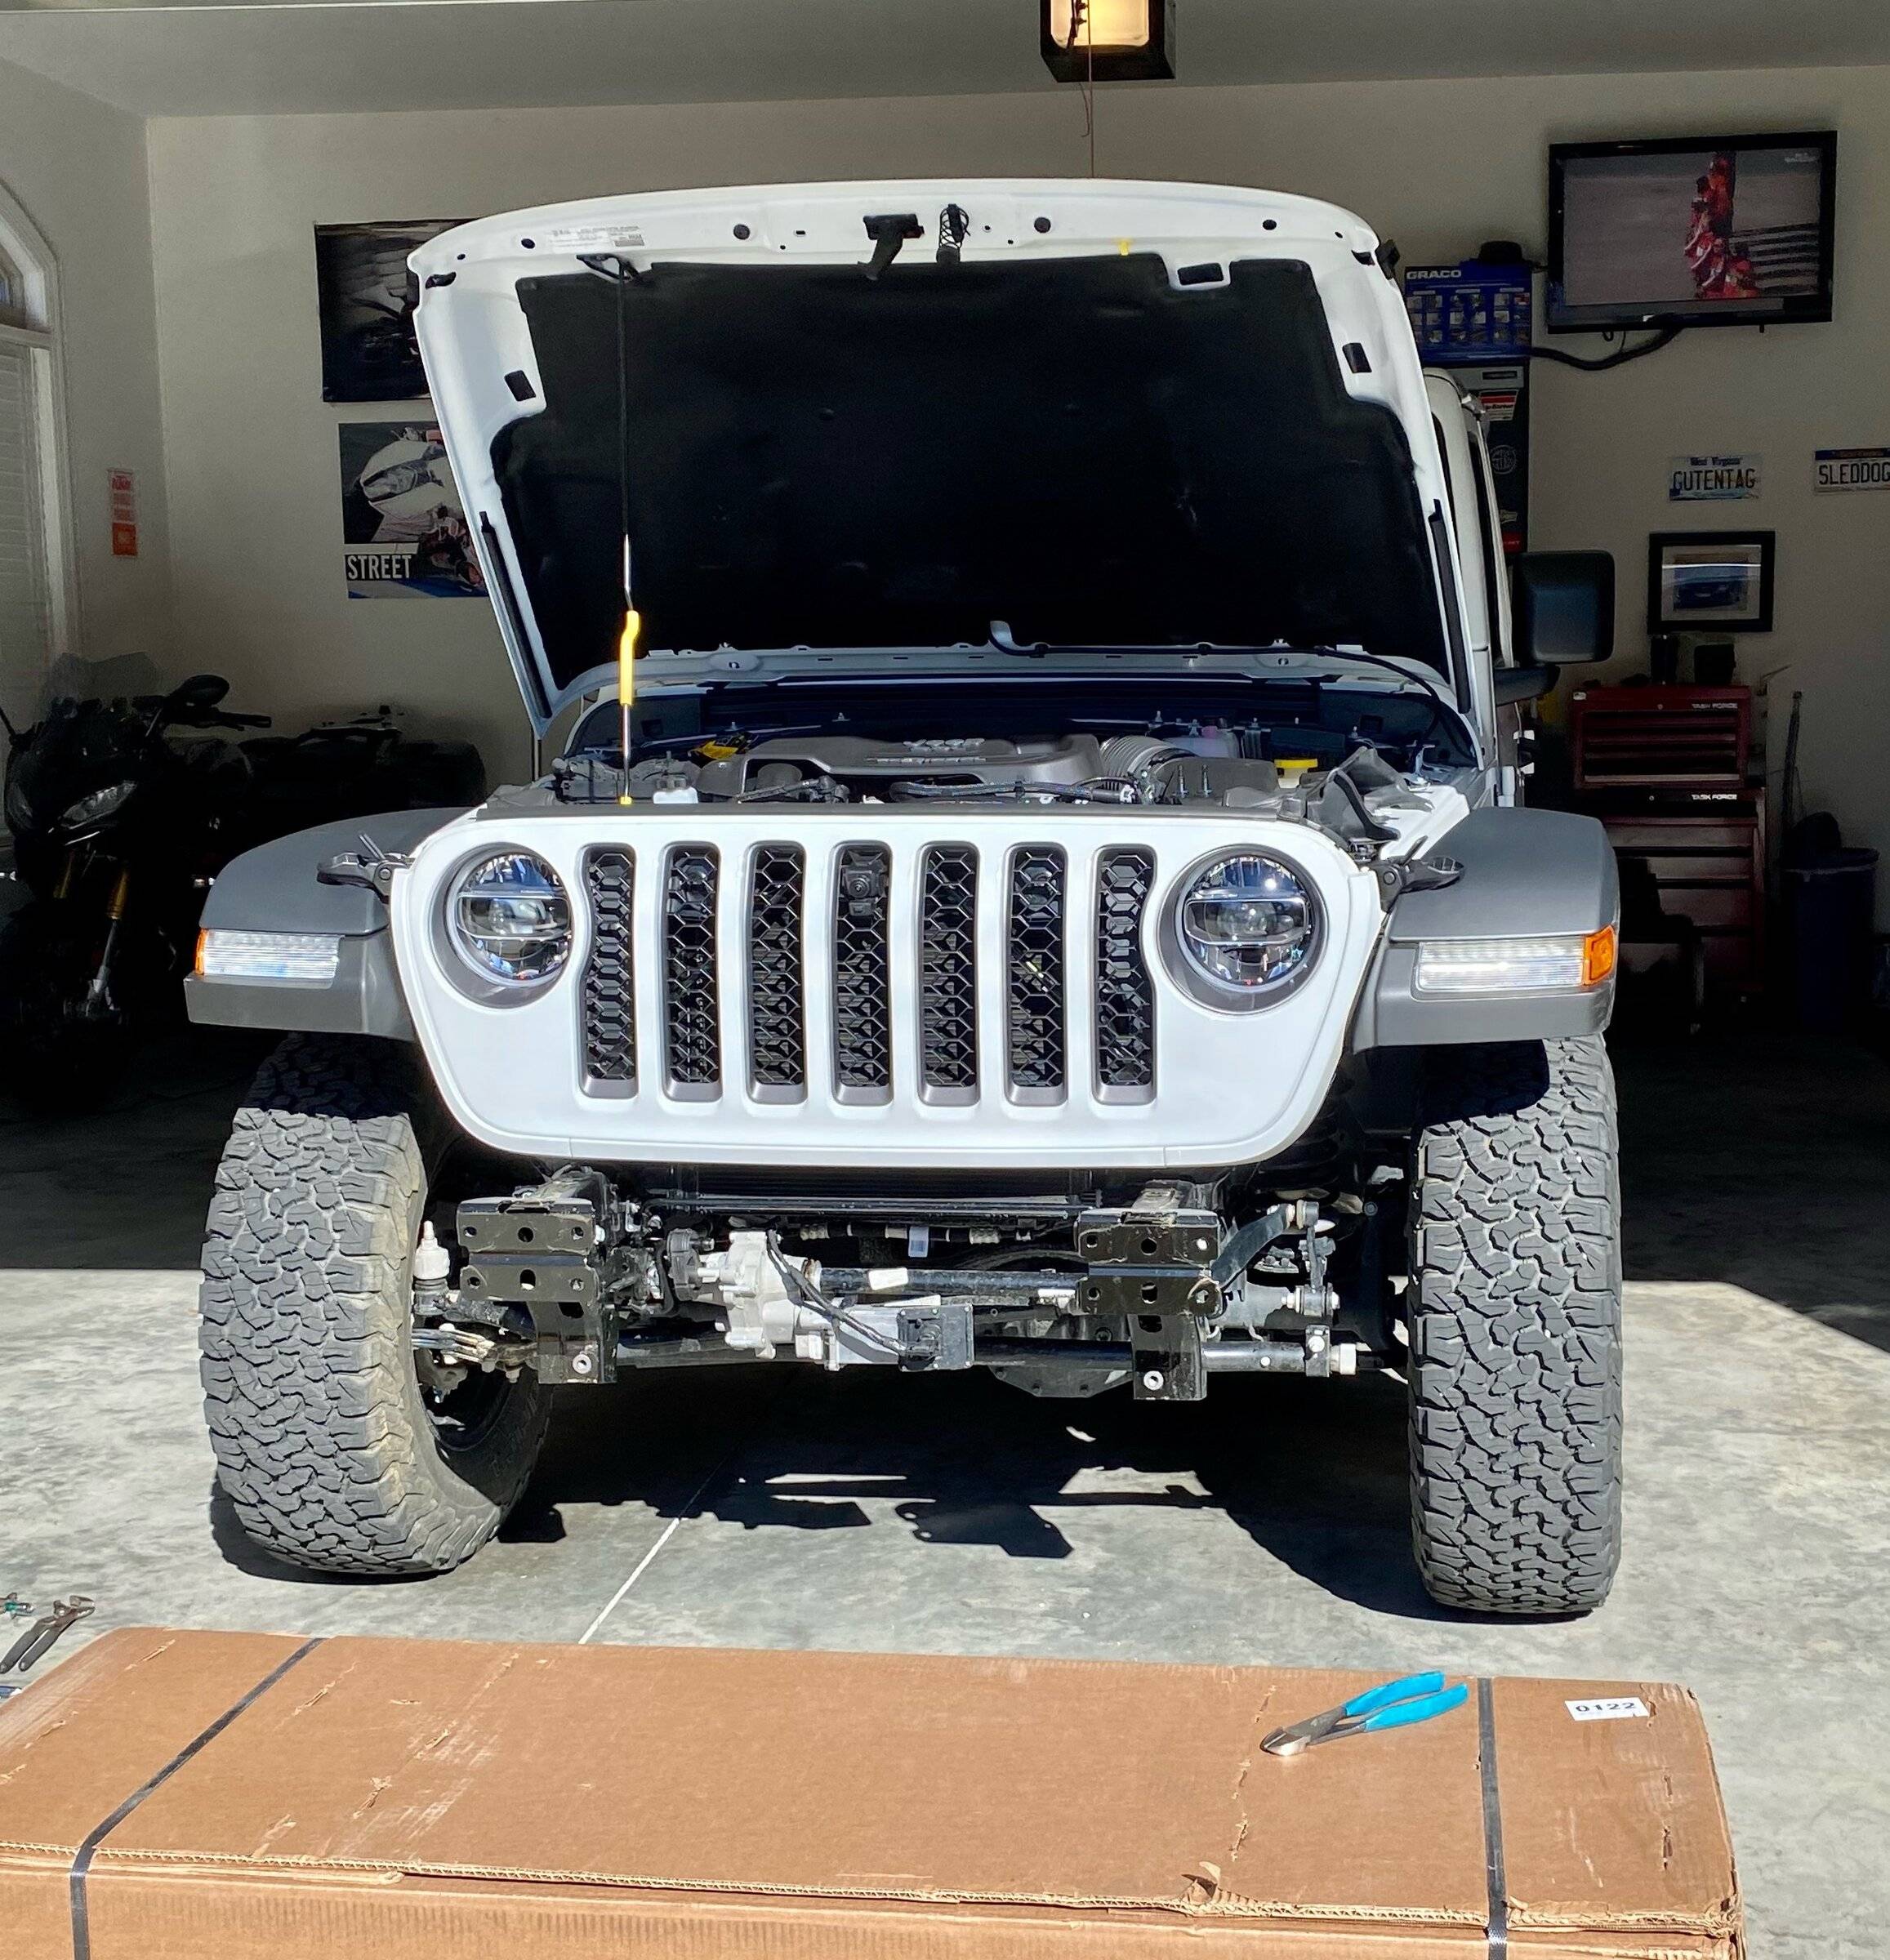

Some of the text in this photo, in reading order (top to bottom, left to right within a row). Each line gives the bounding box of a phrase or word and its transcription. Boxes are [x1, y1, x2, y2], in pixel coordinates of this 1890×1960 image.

[1406, 270, 1462, 280] GRACO
[1673, 469, 1756, 491] GUTENTAG
[1819, 461, 1890, 484] SLEDDOG
[347, 555, 412, 580] STREET
[1575, 1702, 1636, 1713] 0122
